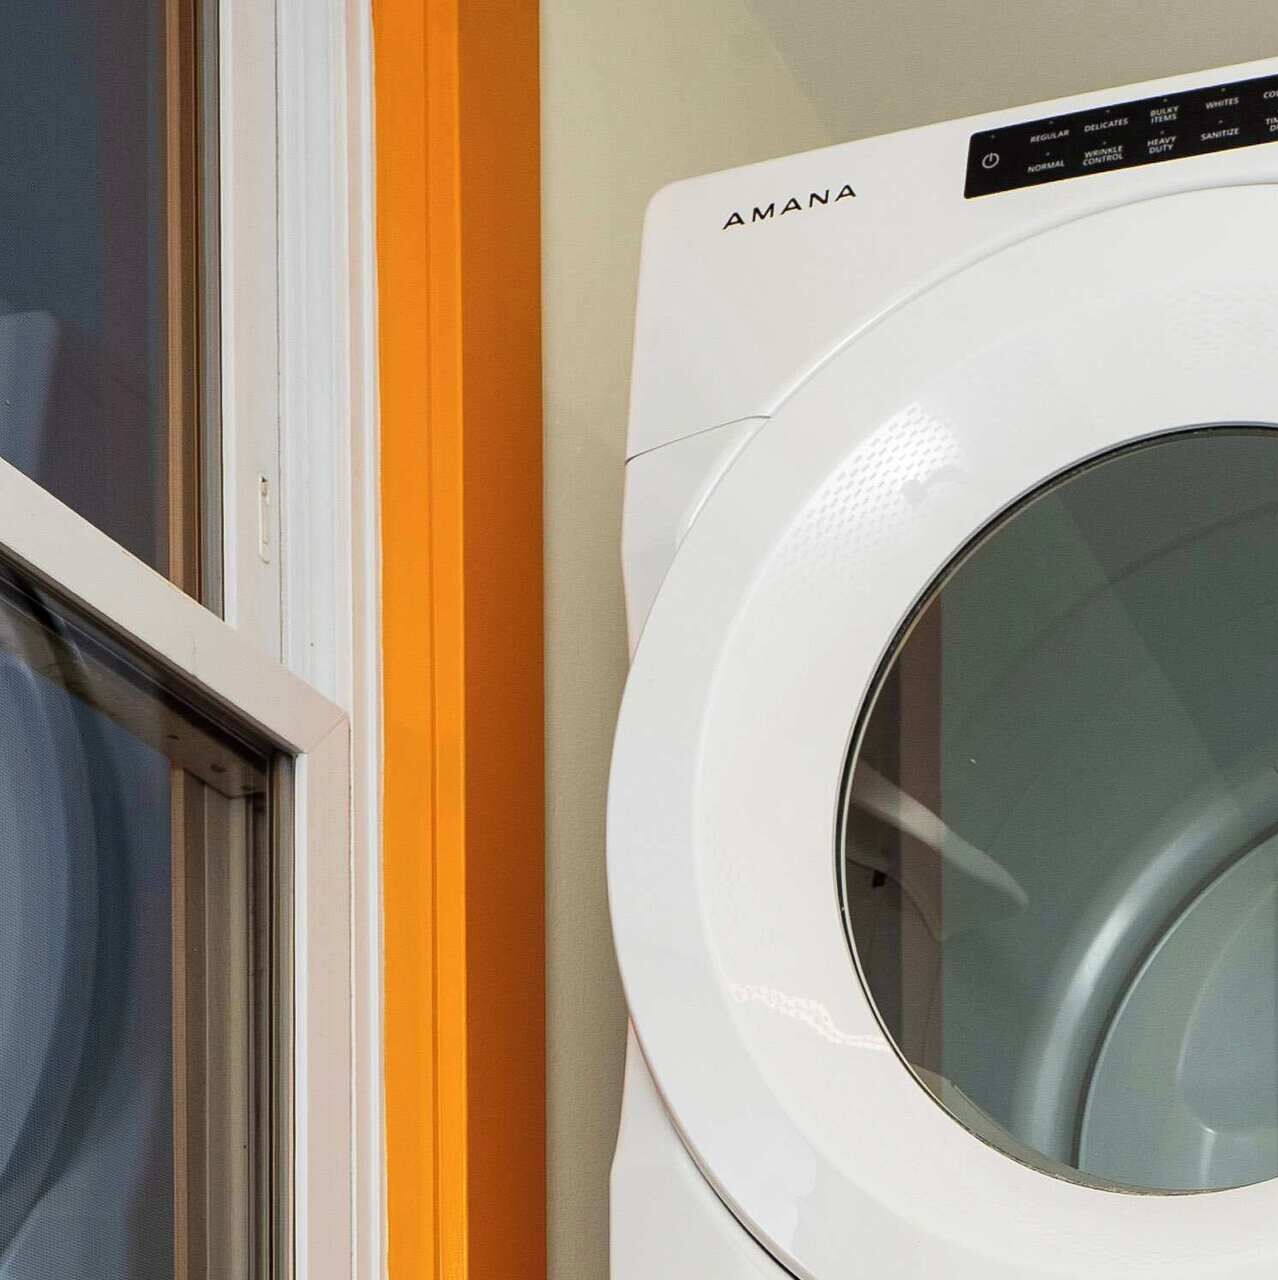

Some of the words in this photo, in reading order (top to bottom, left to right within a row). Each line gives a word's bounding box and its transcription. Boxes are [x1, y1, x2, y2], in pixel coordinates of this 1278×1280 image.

[1205, 97, 1239, 110] WHITES
[1150, 105, 1179, 117] BULKY
[1084, 118, 1128, 132] DELICATES
[1151, 113, 1177, 124] ITEMS
[1030, 129, 1070, 143] REGULAR
[1200, 128, 1240, 141] SANITIZE
[1147, 136, 1176, 147] HEAVY
[1084, 145, 1123, 158] WRINKLE
[1149, 144, 1174, 154] DUTY
[1082, 153, 1123, 166] CONTROL
[1027, 160, 1065, 173] NORMAL
[722, 184, 856, 230] AMANA
